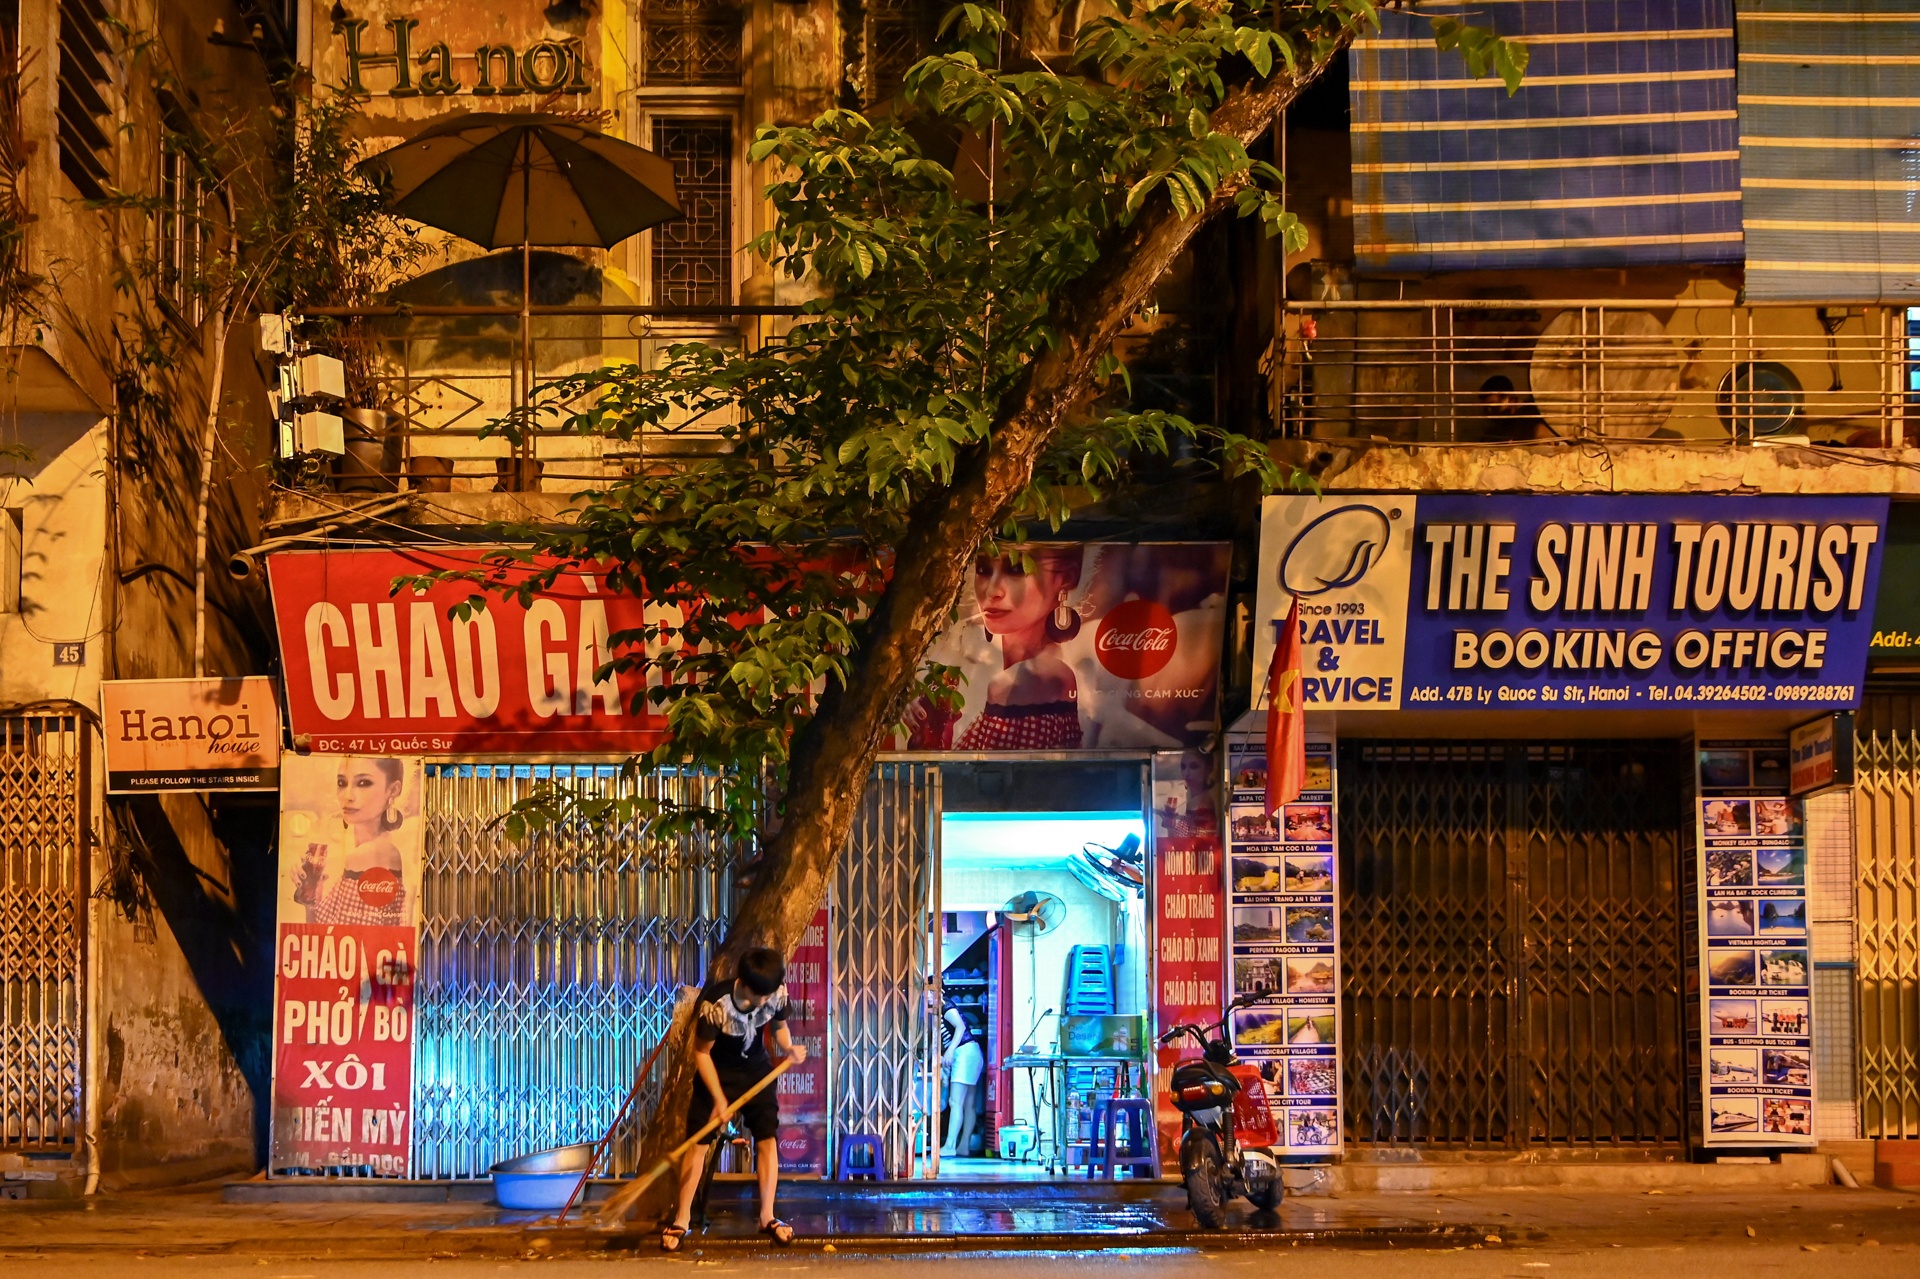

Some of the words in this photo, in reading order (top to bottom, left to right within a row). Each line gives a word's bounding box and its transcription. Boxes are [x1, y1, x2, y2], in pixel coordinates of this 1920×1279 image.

[332, 16, 592, 102] Hanoi
[1424, 521, 1516, 611] THE
[1529, 520, 1658, 612] SINH
[1672, 520, 1878, 612] TOURIST
[1298, 602, 1332, 616] Since
[1336, 602, 1365, 616] 1993
[523, 571, 623, 718] GÀ
[1453, 627, 1663, 670] BOOKING
[1673, 627, 1828, 670] OFFICE
[1869, 630, 1913, 648] Add:
[59, 646, 80, 663] 45
[1317, 646, 1340, 672] &
[1267, 677, 1393, 704] RVICE
[1409, 686, 1443, 702] Add.
[1447, 686, 1473, 702] 47B
[1477, 686, 1493, 705] Ly
[1498, 685, 1537, 702] Quoc
[1541, 685, 1559, 702] Su
[1588, 685, 1630, 702] Hanoi
[120, 704, 260, 742] Hanoi
[207, 732, 261, 754] house
[349, 739, 365, 751] 47
[369, 739, 386, 753] Lý
[390, 736, 428, 751] Quốc
[131, 777, 159, 785] PLEASE
[160, 777, 191, 785] FOLLOW
[192, 776, 207, 784] THE
[208, 776, 234, 784] STAIRS
[236, 775, 260, 783] INSIDE
[1165, 889, 1187, 919] CHÁO
[282, 926, 357, 980] CHÁO
[376, 942, 410, 986] GÀ
[1161, 931, 1183, 963] CHÁO
[1197, 936, 1219, 962] XANH
[799, 962, 820, 984] BEAN
[1163, 975, 1186, 1006] CHÁO
[283, 985, 355, 1046] PHỞ
[373, 997, 408, 1042] BÒ
[299, 1053, 387, 1091] XÔI
[777, 1073, 815, 1094] BEVERAGE
[361, 1101, 407, 1146] MỲ
